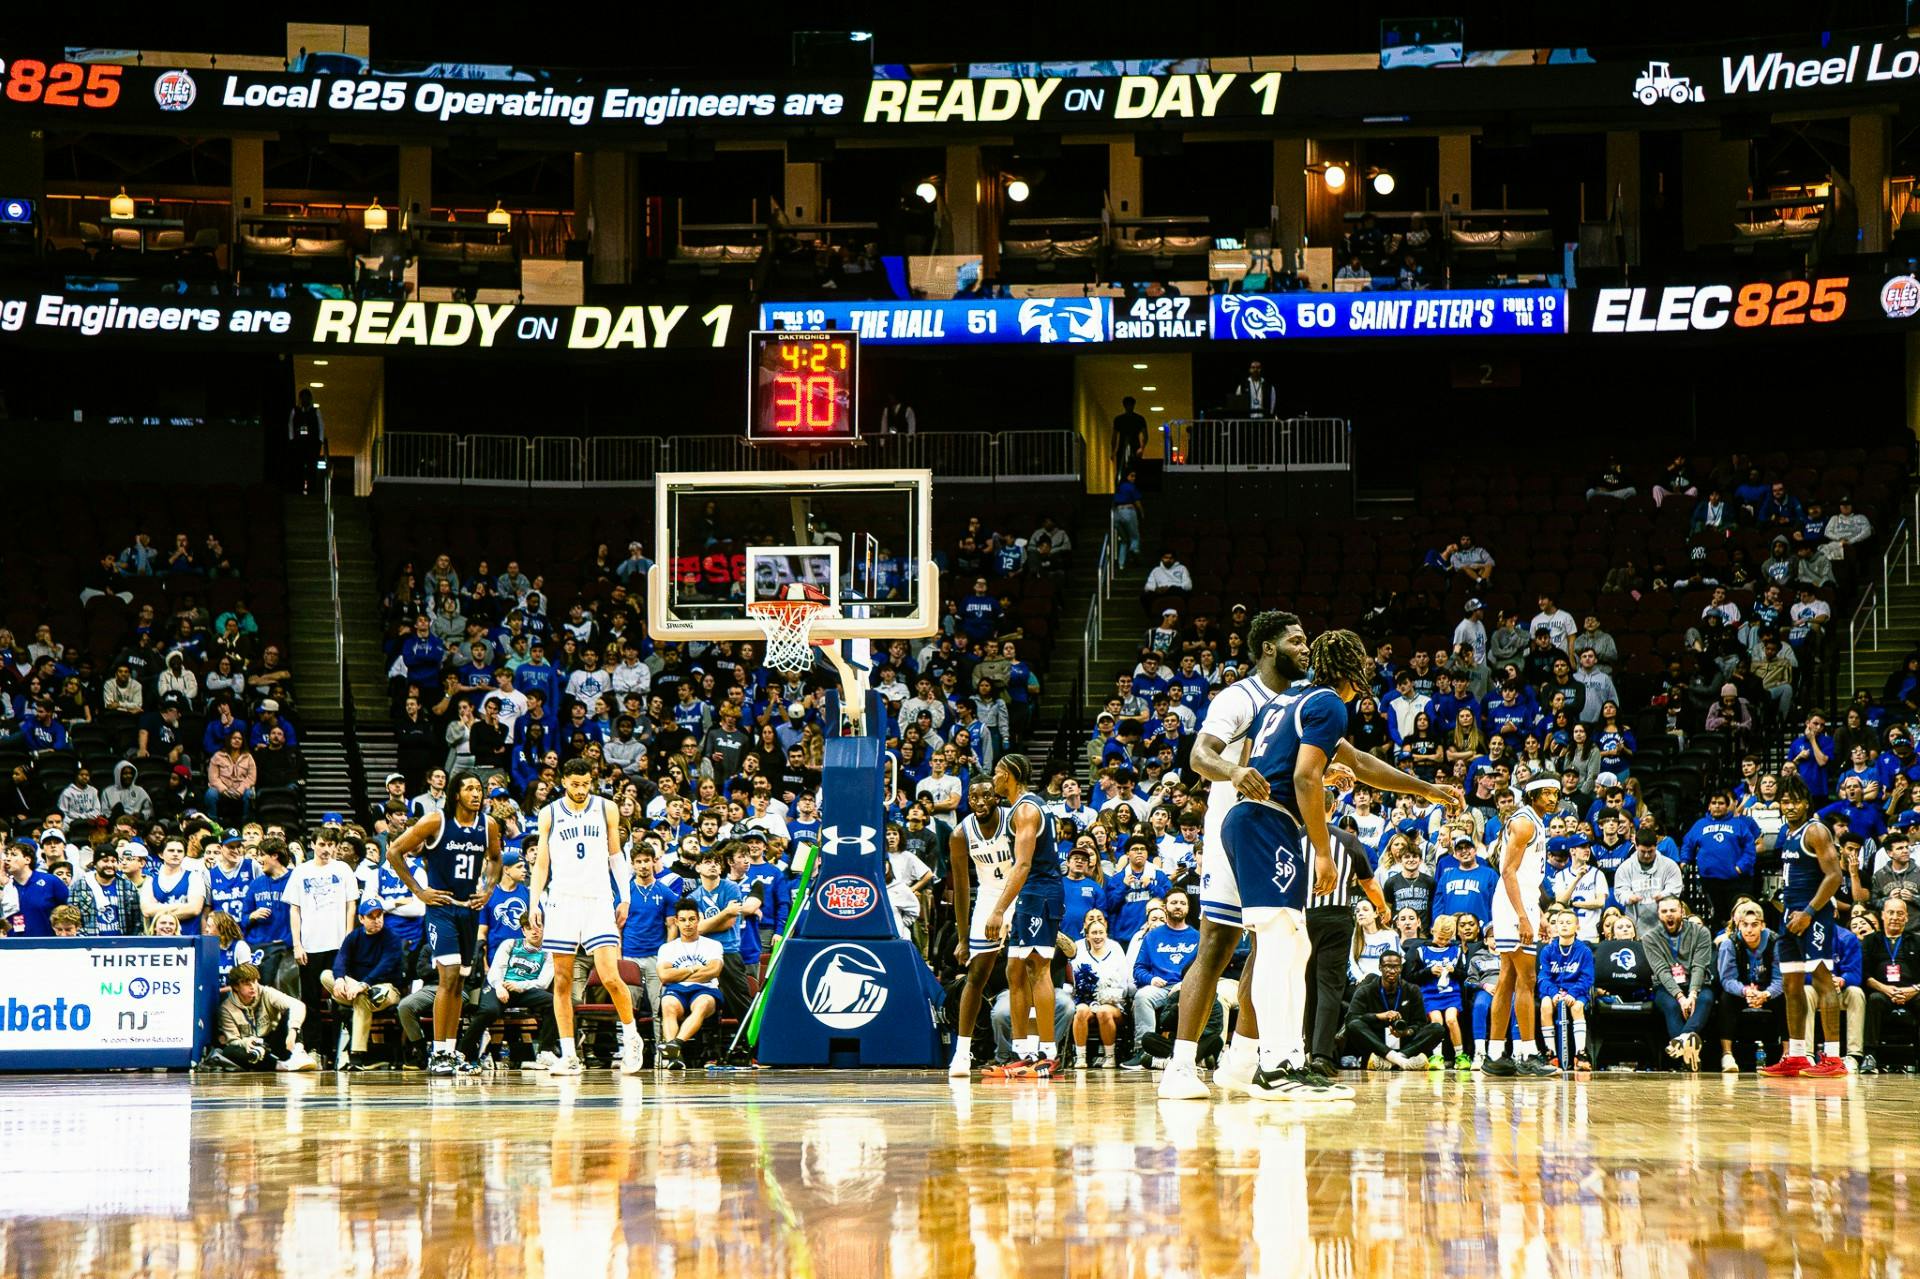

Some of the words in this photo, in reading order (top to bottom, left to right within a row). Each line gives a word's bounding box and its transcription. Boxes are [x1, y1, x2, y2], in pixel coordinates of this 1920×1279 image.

[1723, 46, 1860, 94] Wheel
[1867, 43, 1920, 81] Lo
[222, 76, 321, 109] Local
[329, 79, 407, 111] 825
[415, 84, 594, 125] Operating
[602, 88, 775, 126] Engineers
[784, 94, 843, 115] are
[864, 77, 1063, 122] READY
[1065, 89, 1104, 111] ON
[1114, 73, 1236, 118] DAY
[1250, 73, 1282, 115] 1
[0, 303, 27, 330] g
[36, 295, 220, 335] Engineers
[230, 309, 291, 333] are
[1130, 298, 1191, 320] 4:27
[1297, 303, 1335, 327] 50
[1349, 300, 1412, 330] SAINT
[1413, 299, 1494, 328] PETER'S
[1503, 297, 1534, 312] FOULS
[1537, 296, 1556, 311] 10
[313, 300, 515, 346] READY
[518, 317, 558, 340] ON
[568, 306, 688, 348] DAY
[702, 305, 732, 347] 1
[806, 310, 824, 324] 10
[850, 310, 889, 339] THE
[891, 309, 945, 338] HALL
[967, 310, 997, 334] 51
[1515, 312, 1534, 326] TOL
[1541, 312, 1553, 327] 2
[1115, 321, 1155, 339] 2ND
[1158, 318, 1206, 338] HALF
[782, 343, 846, 372] 4:27
[1480, 365, 1493, 384] 2
[774, 376, 835, 428] 30
[576, 842, 585, 859] 9
[454, 853, 475, 880] 21
[994, 867, 1003, 880] 4
[1275, 862, 1293, 878] SP
[825, 883, 870, 897] Jersey
[221, 900, 244, 922] 13
[90, 954, 188, 967] THIRTEEN
[100, 982, 123, 995] NJ
[152, 981, 181, 995] PBS
